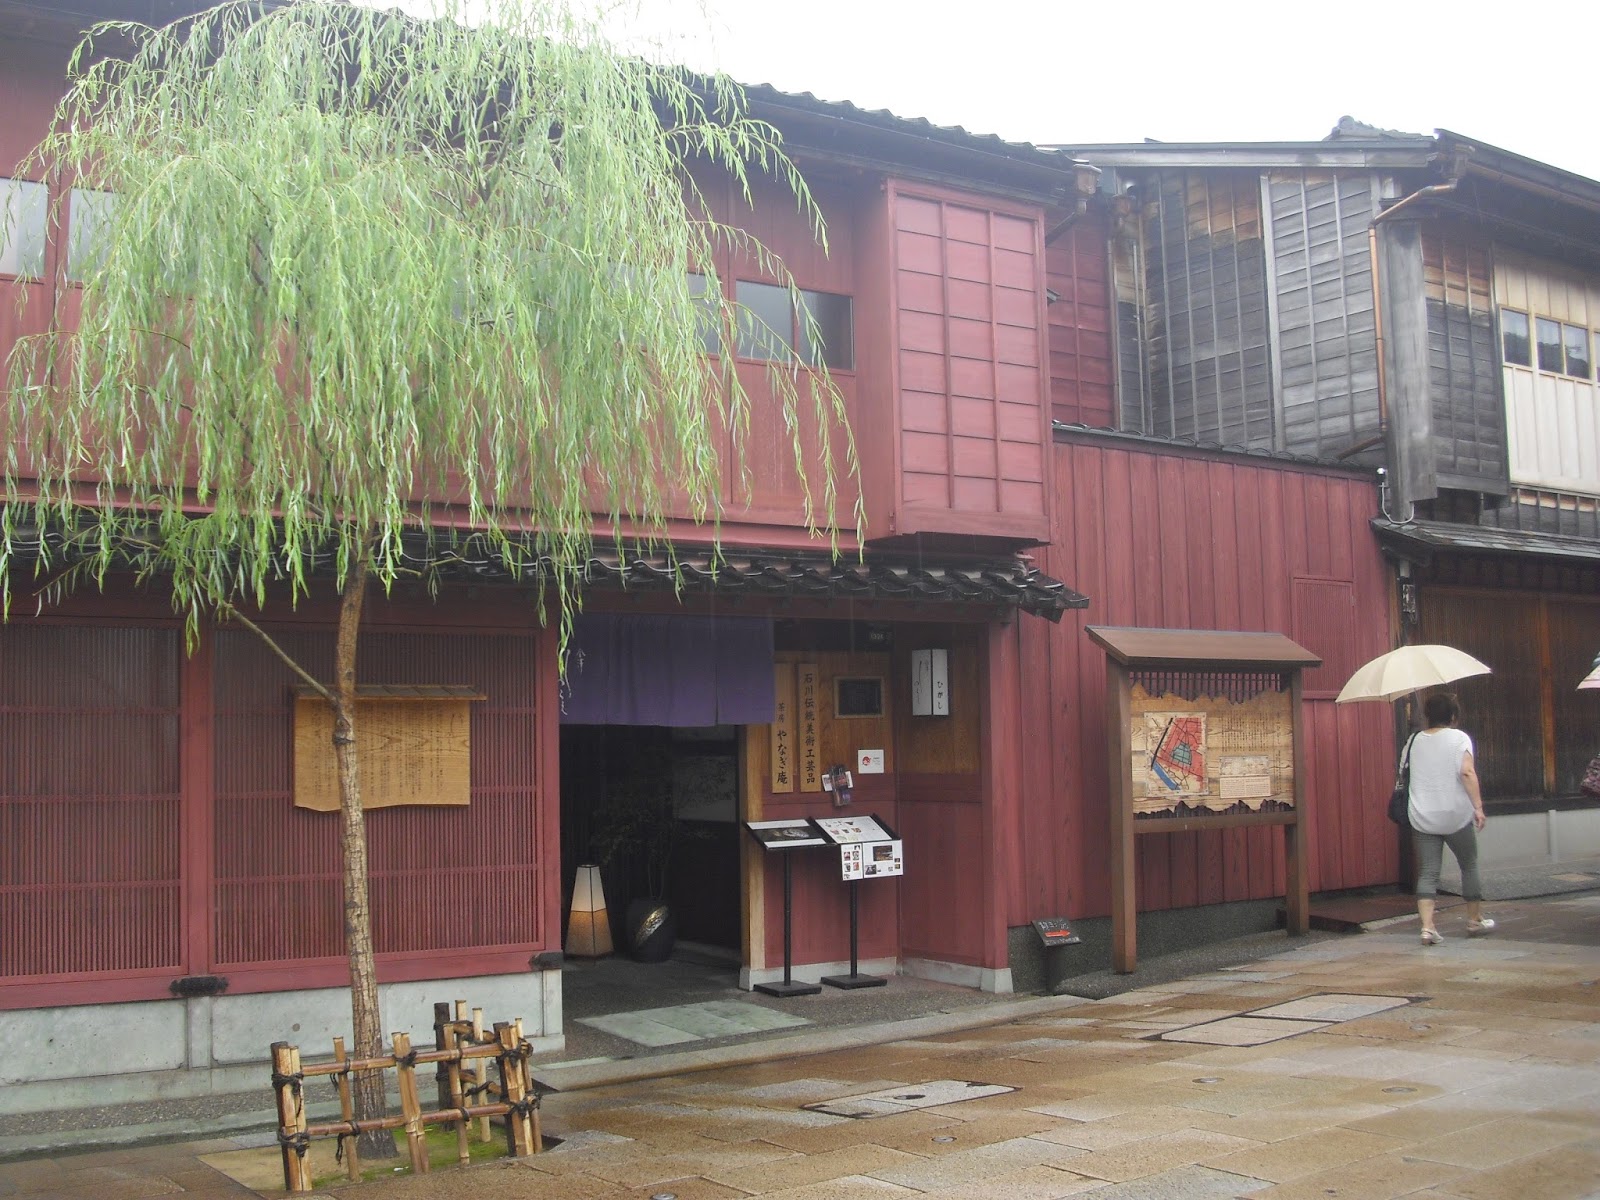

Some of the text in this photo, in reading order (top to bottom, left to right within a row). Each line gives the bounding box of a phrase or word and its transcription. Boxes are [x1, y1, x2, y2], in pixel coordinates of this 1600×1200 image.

[776, 703, 788, 785] 茶房 やなぎ庵
[804, 673, 816, 784] 石川伝統美術工芸品
